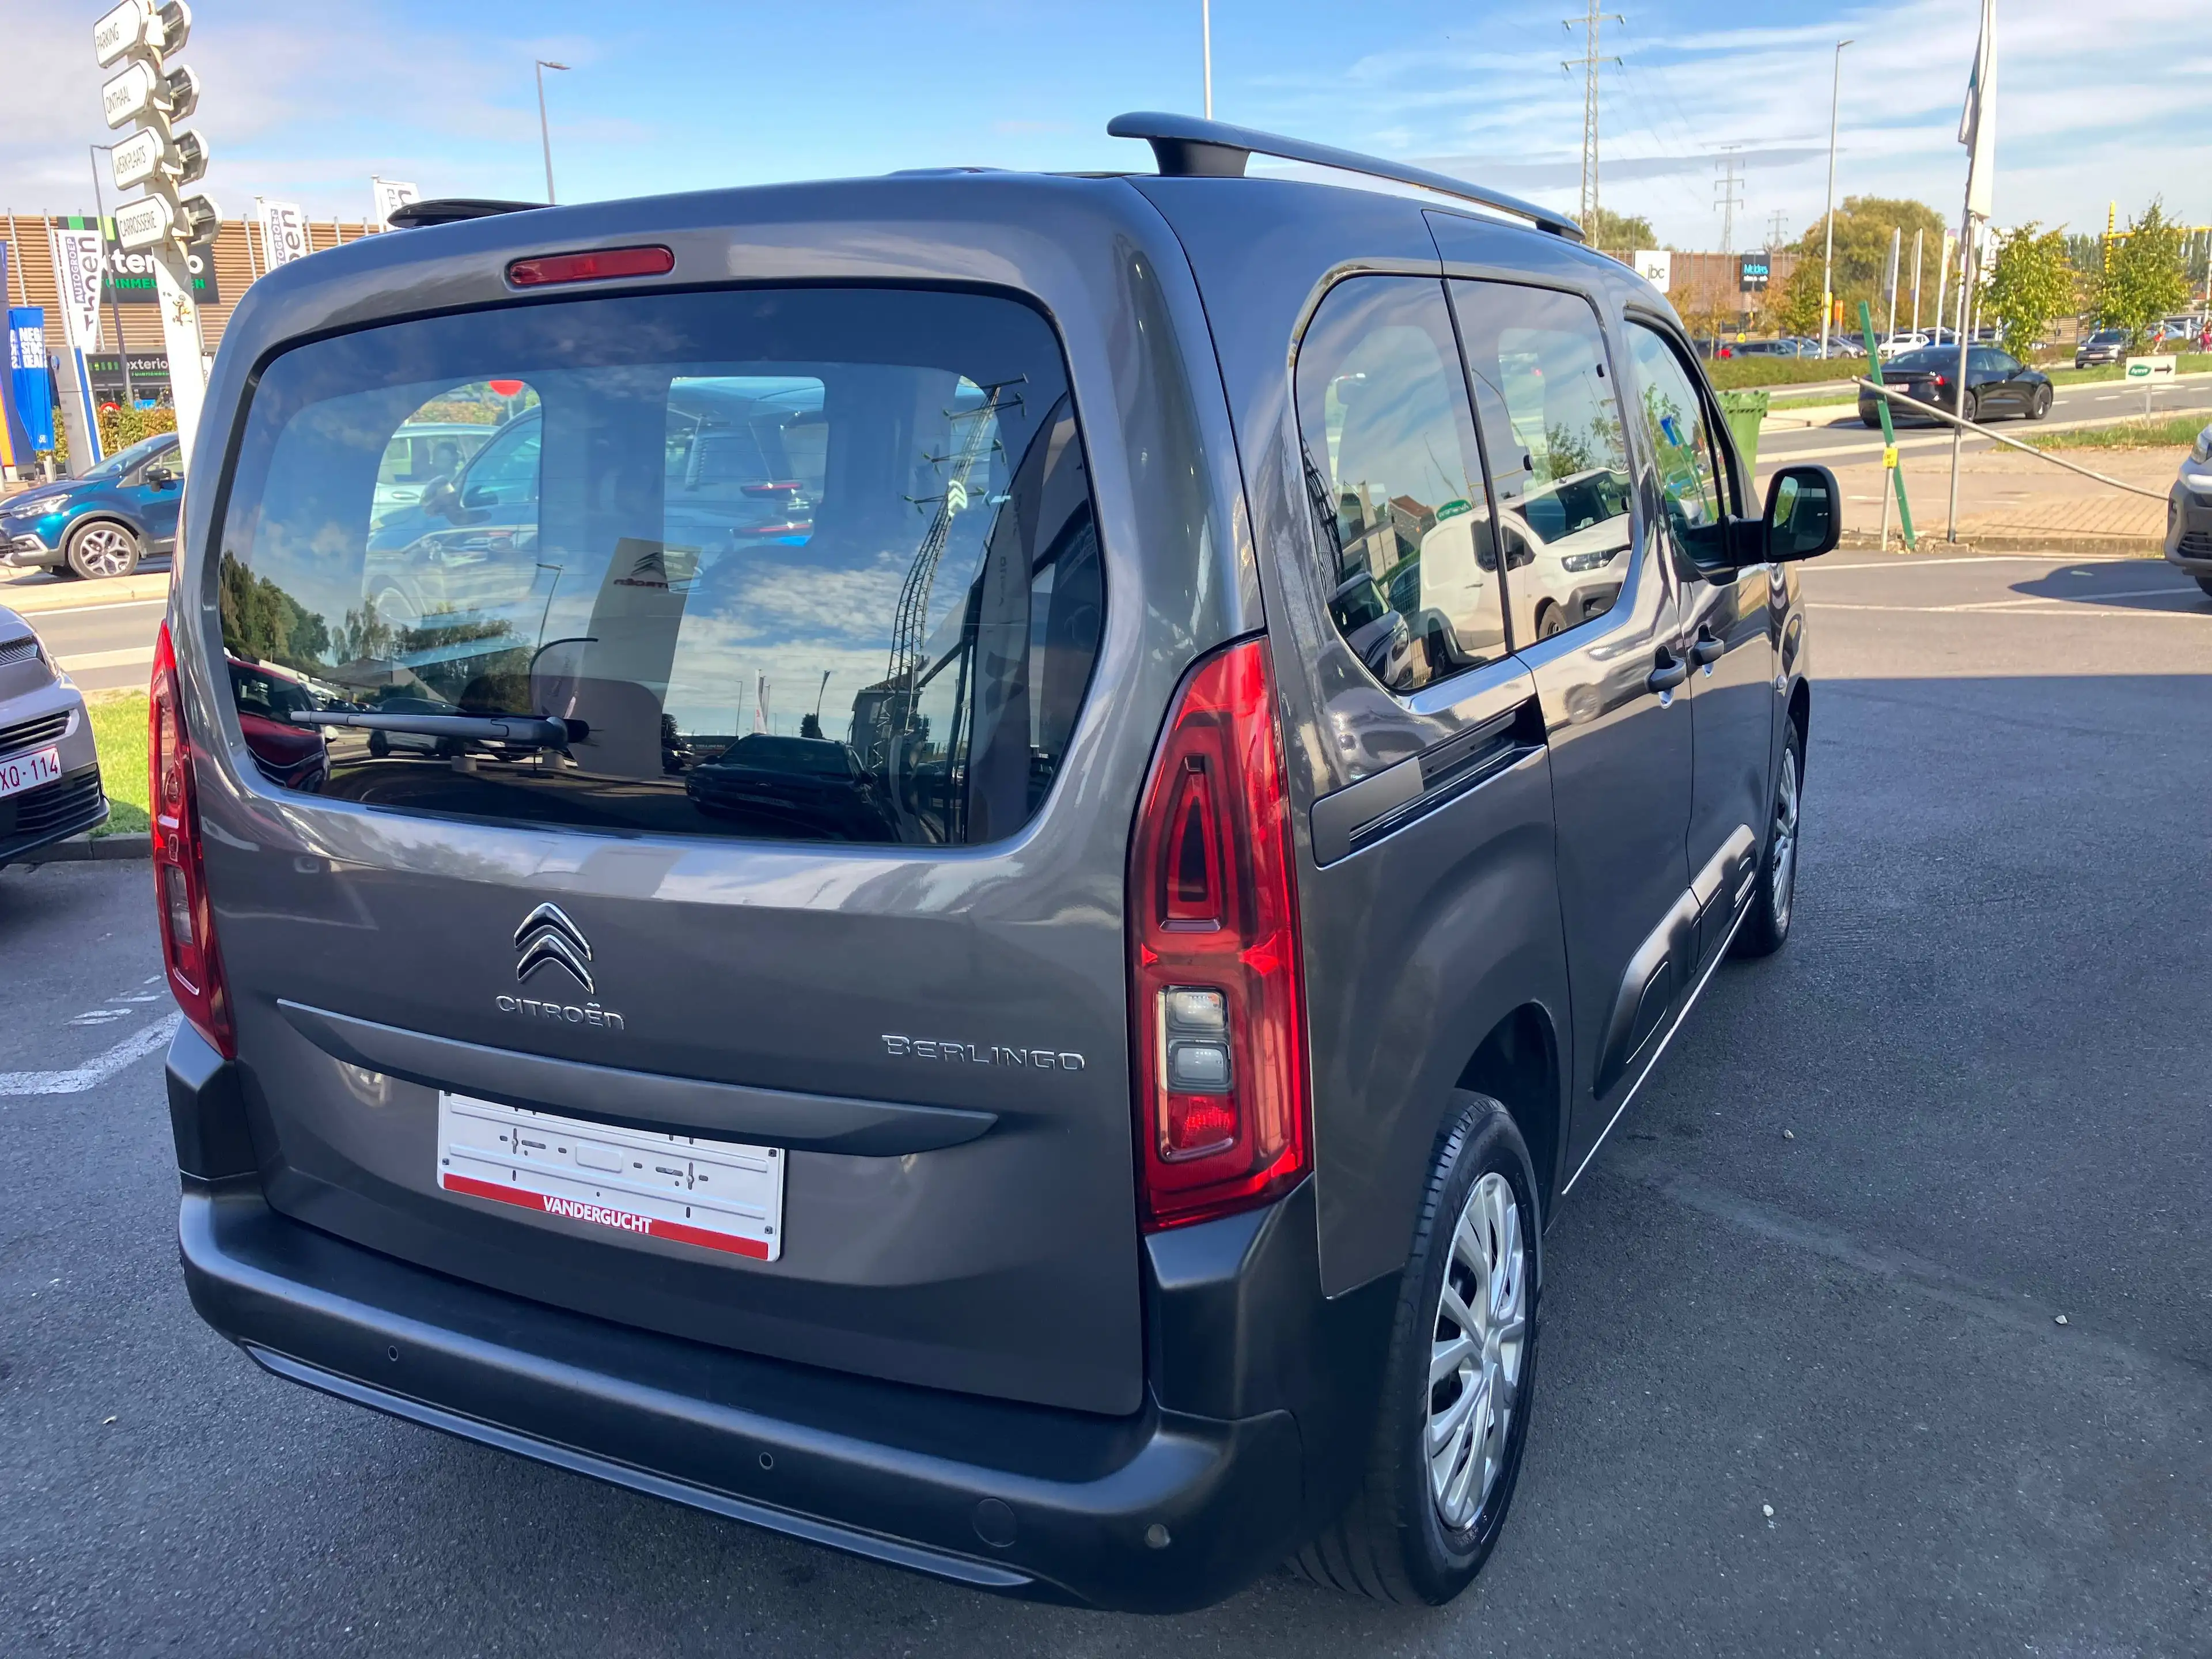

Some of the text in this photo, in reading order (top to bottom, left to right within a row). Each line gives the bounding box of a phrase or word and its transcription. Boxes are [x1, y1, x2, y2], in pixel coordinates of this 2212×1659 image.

[96, 22, 119, 52] PARKING
[105, 86, 131, 113] ONTHAAL
[114, 145, 146, 175] WERKPLAATS
[119, 211, 157, 237] CARROSSERIE
[66, 237, 85, 303] AUTOGROEP
[881, 1035, 1086, 1070] BERLINGO
[543, 1195, 653, 1233] VANDERGUCHT
